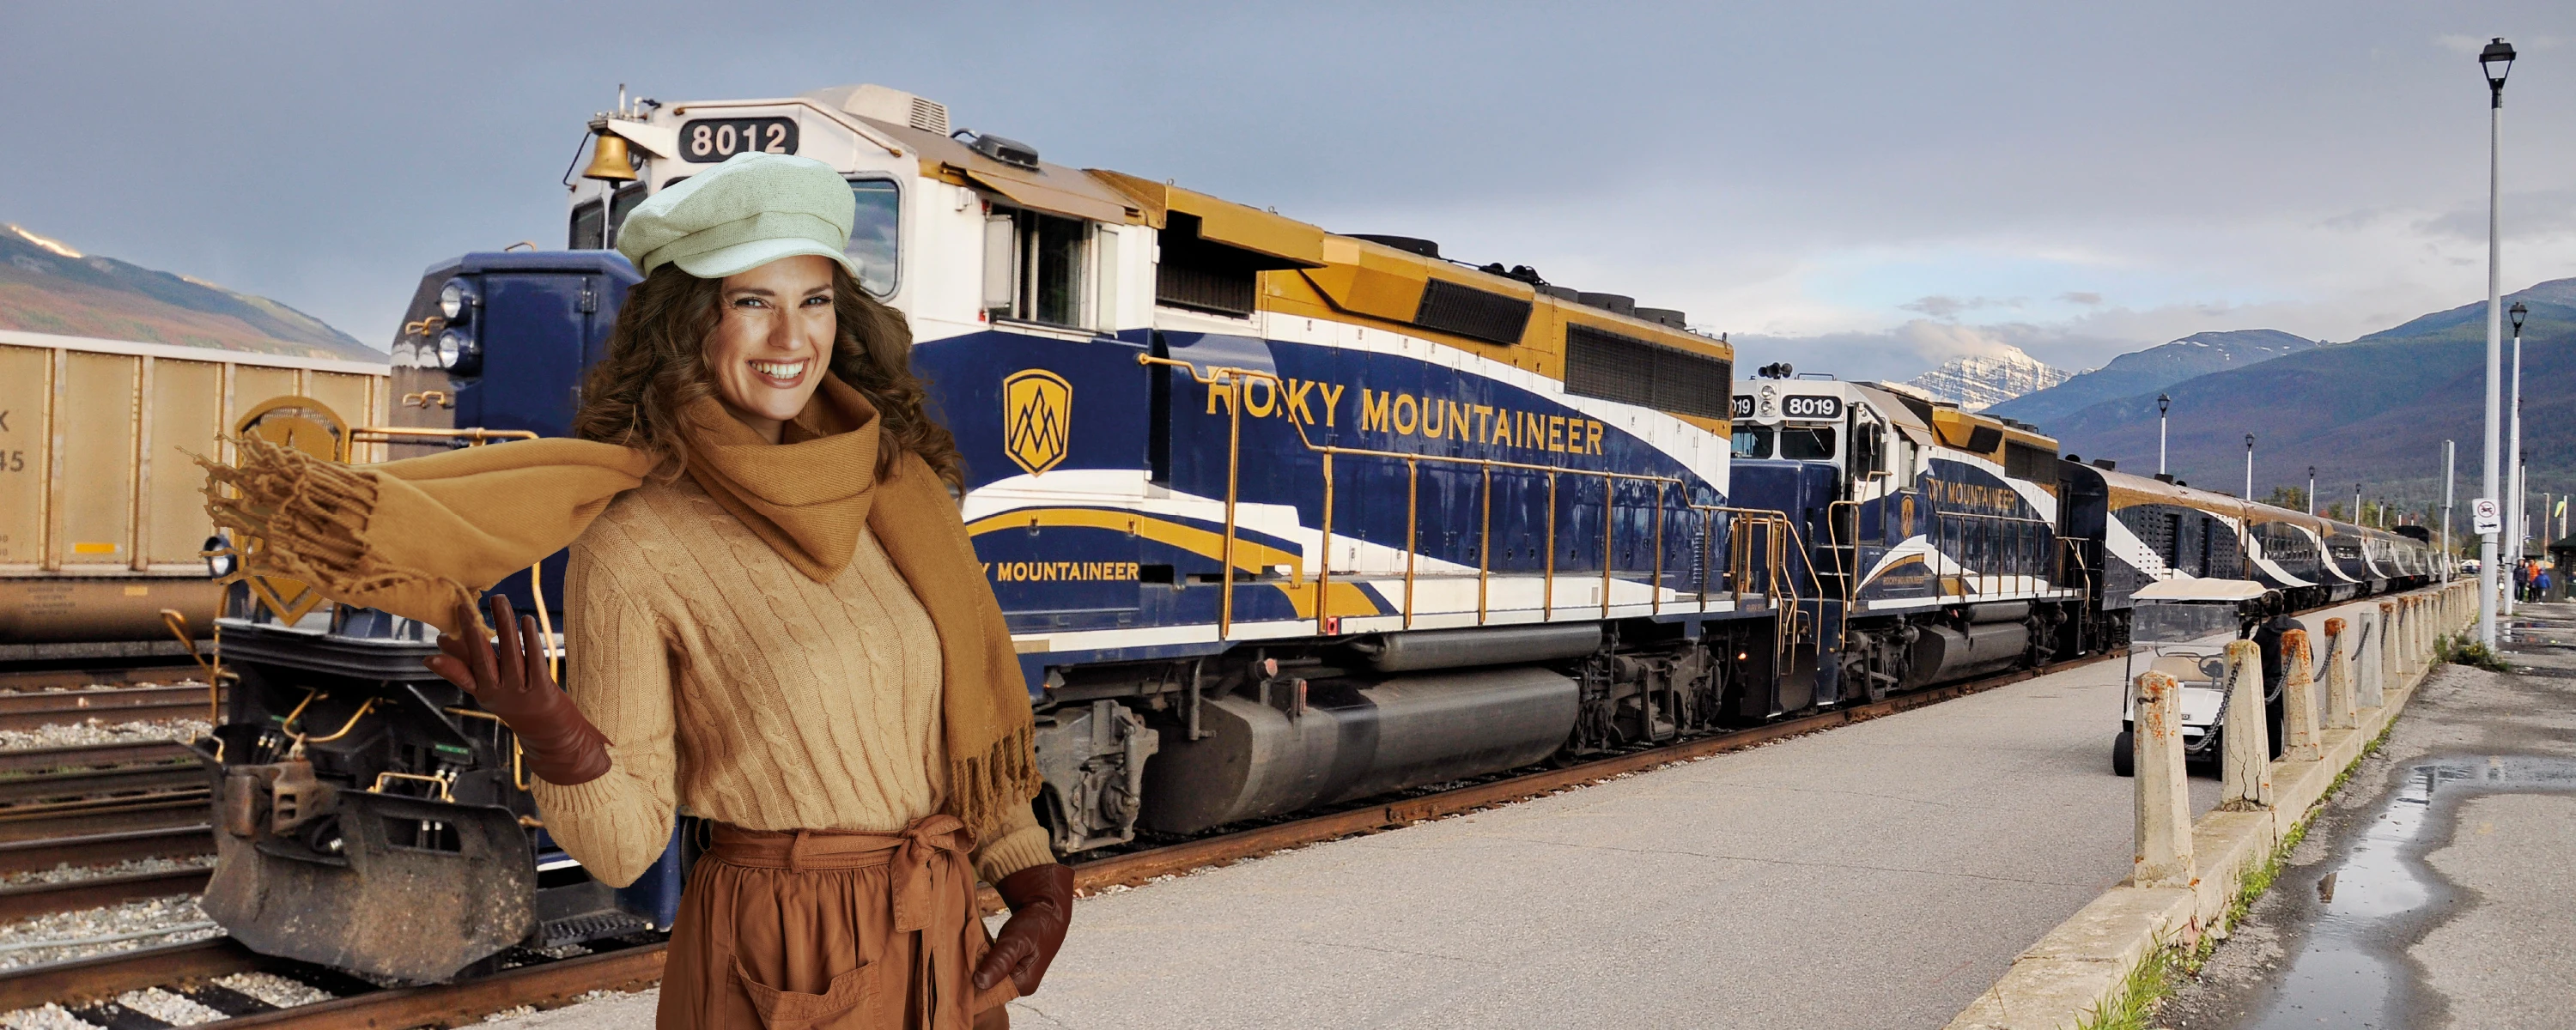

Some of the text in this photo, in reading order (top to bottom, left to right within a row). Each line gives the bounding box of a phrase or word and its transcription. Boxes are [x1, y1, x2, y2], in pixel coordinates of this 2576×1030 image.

[691, 123, 787, 156] 8012
[1206, 365, 1604, 456] ROKY MOUNTAINEER
[1789, 398, 1835, 415] 8019
[1947, 481, 2015, 511] MOUNTAINEER
[997, 561, 1139, 582] MOUNTAINEER
